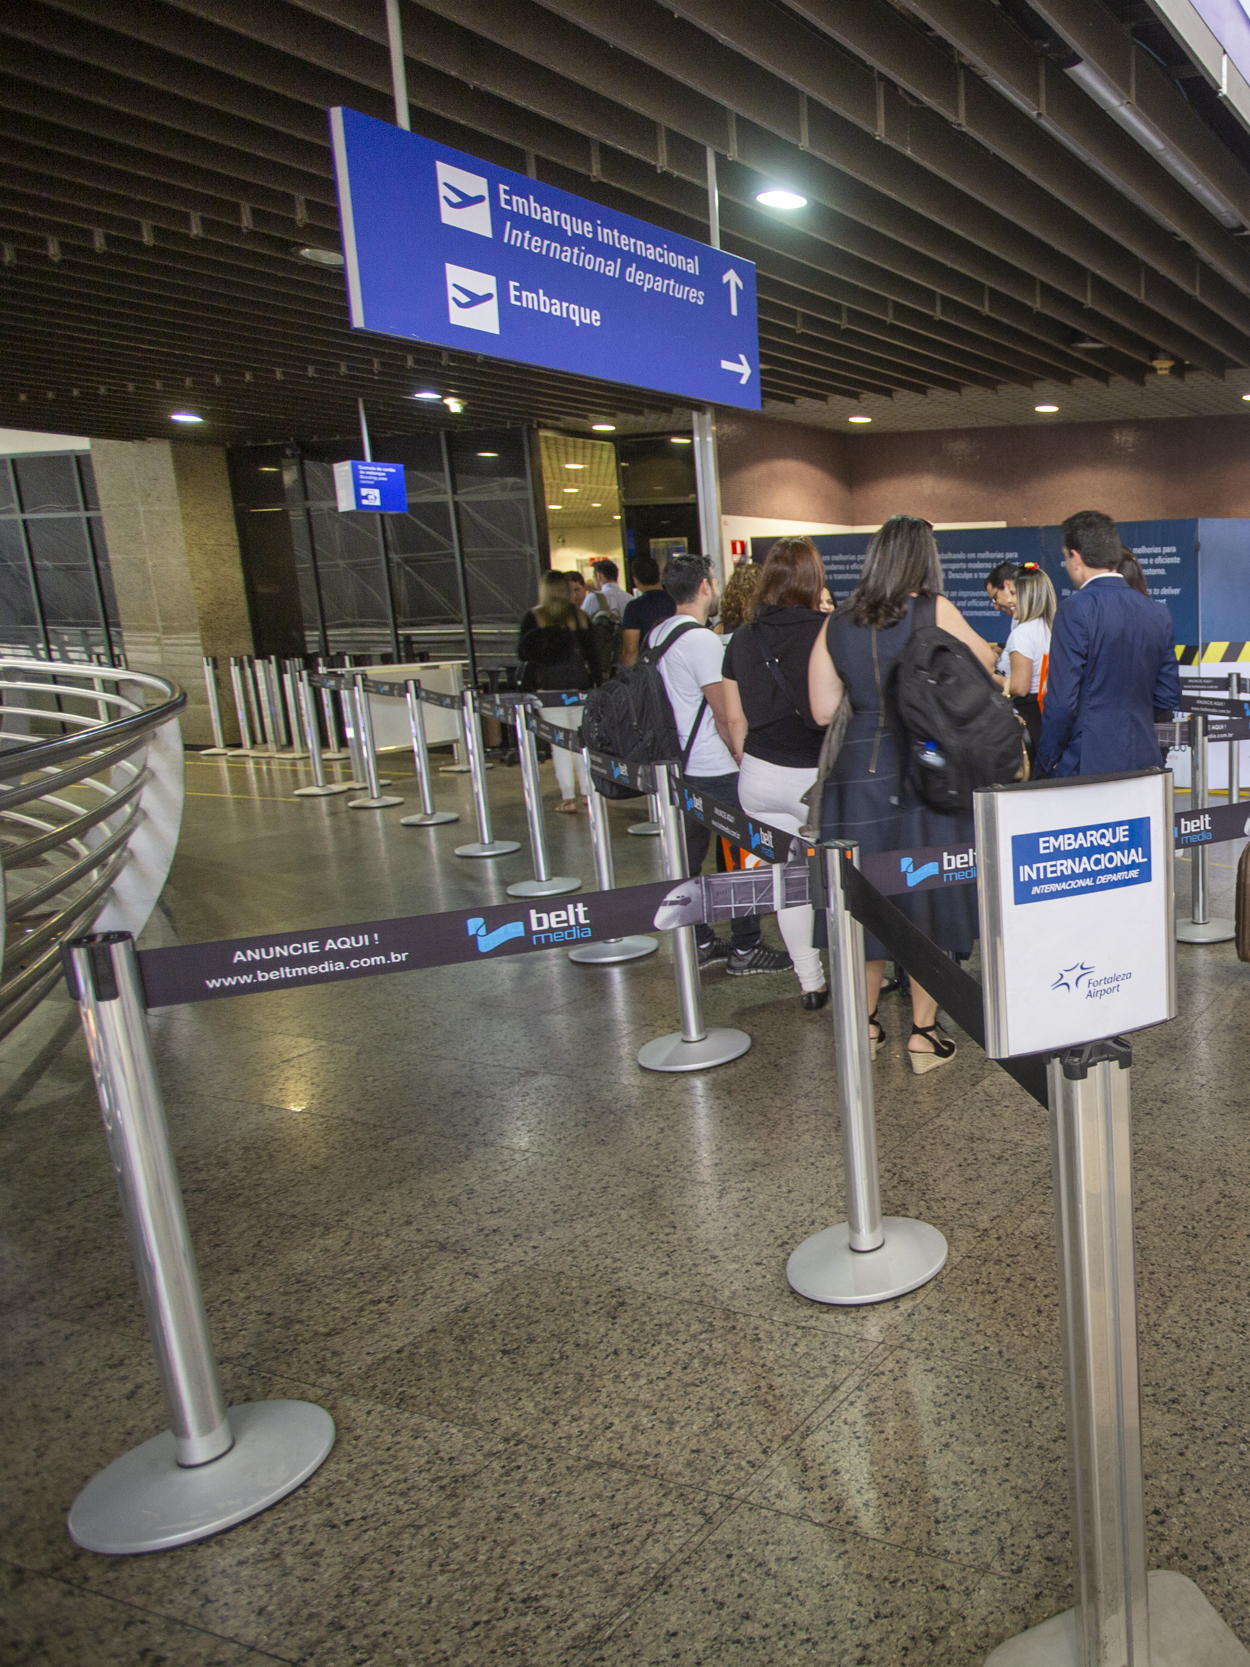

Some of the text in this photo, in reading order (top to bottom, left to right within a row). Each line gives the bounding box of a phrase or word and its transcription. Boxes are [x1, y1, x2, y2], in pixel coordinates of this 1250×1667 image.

[499, 183, 700, 277] Embarque internacional
[503, 221, 705, 306] International departures
[508, 280, 602, 328] Embarque
[692, 793, 704, 812] belt
[1181, 814, 1211, 834] belt
[759, 826, 774, 849] belt
[1039, 825, 1129, 854] EMBARQUE
[1181, 831, 1212, 844] media
[943, 848, 977, 870] bel
[1019, 847, 1148, 882] INTERNACIONAL
[943, 867, 977, 882] medi
[1031, 868, 1140, 895] INTERNACIONAL DEPARTURE
[529, 902, 591, 931] belt
[532, 926, 592, 946] media
[232, 941, 320, 964] ANUNCIE
[324, 934, 371, 952] AQUI
[205, 950, 409, 990] www.beltmedia.com.br
[1087, 970, 1132, 988] Fortaleza
[1085, 982, 1120, 1000] Airport
